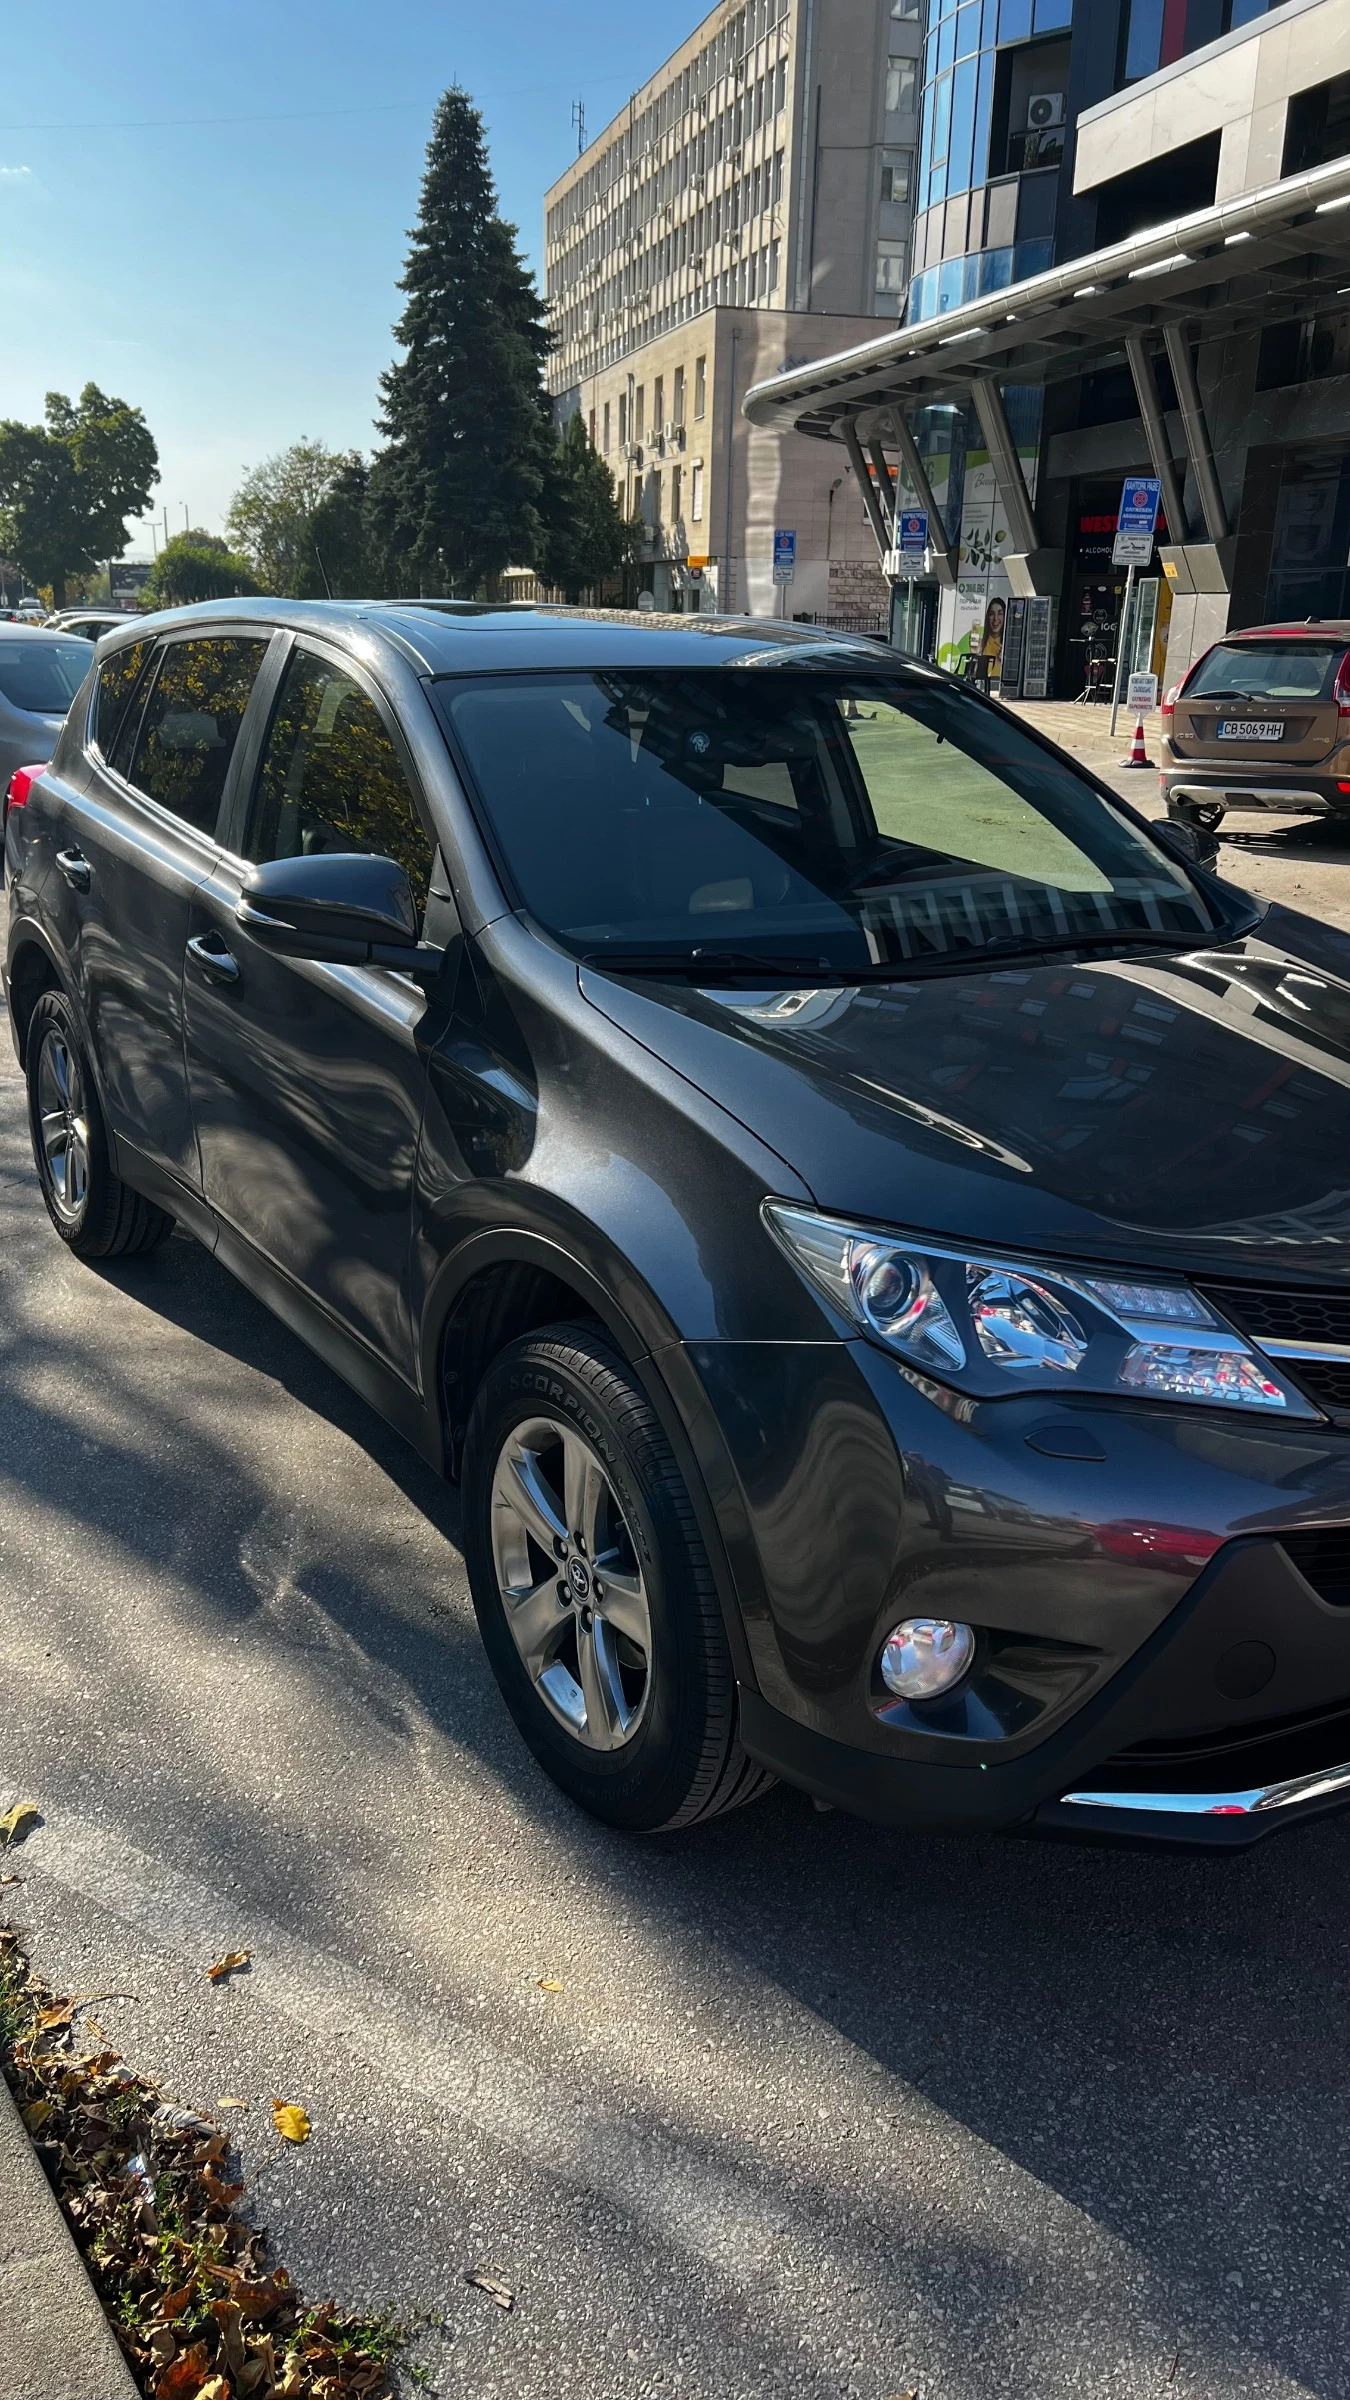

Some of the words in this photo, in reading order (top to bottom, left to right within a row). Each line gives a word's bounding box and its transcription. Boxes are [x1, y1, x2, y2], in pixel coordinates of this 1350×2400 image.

[1085, 546, 1112, 554] ALCOHOL
[1224, 722, 1238, 735] CB
[1239, 723, 1266, 736] 5069
[1266, 724, 1282, 736] HH
[509, 1373, 617, 1464] SCORPION
